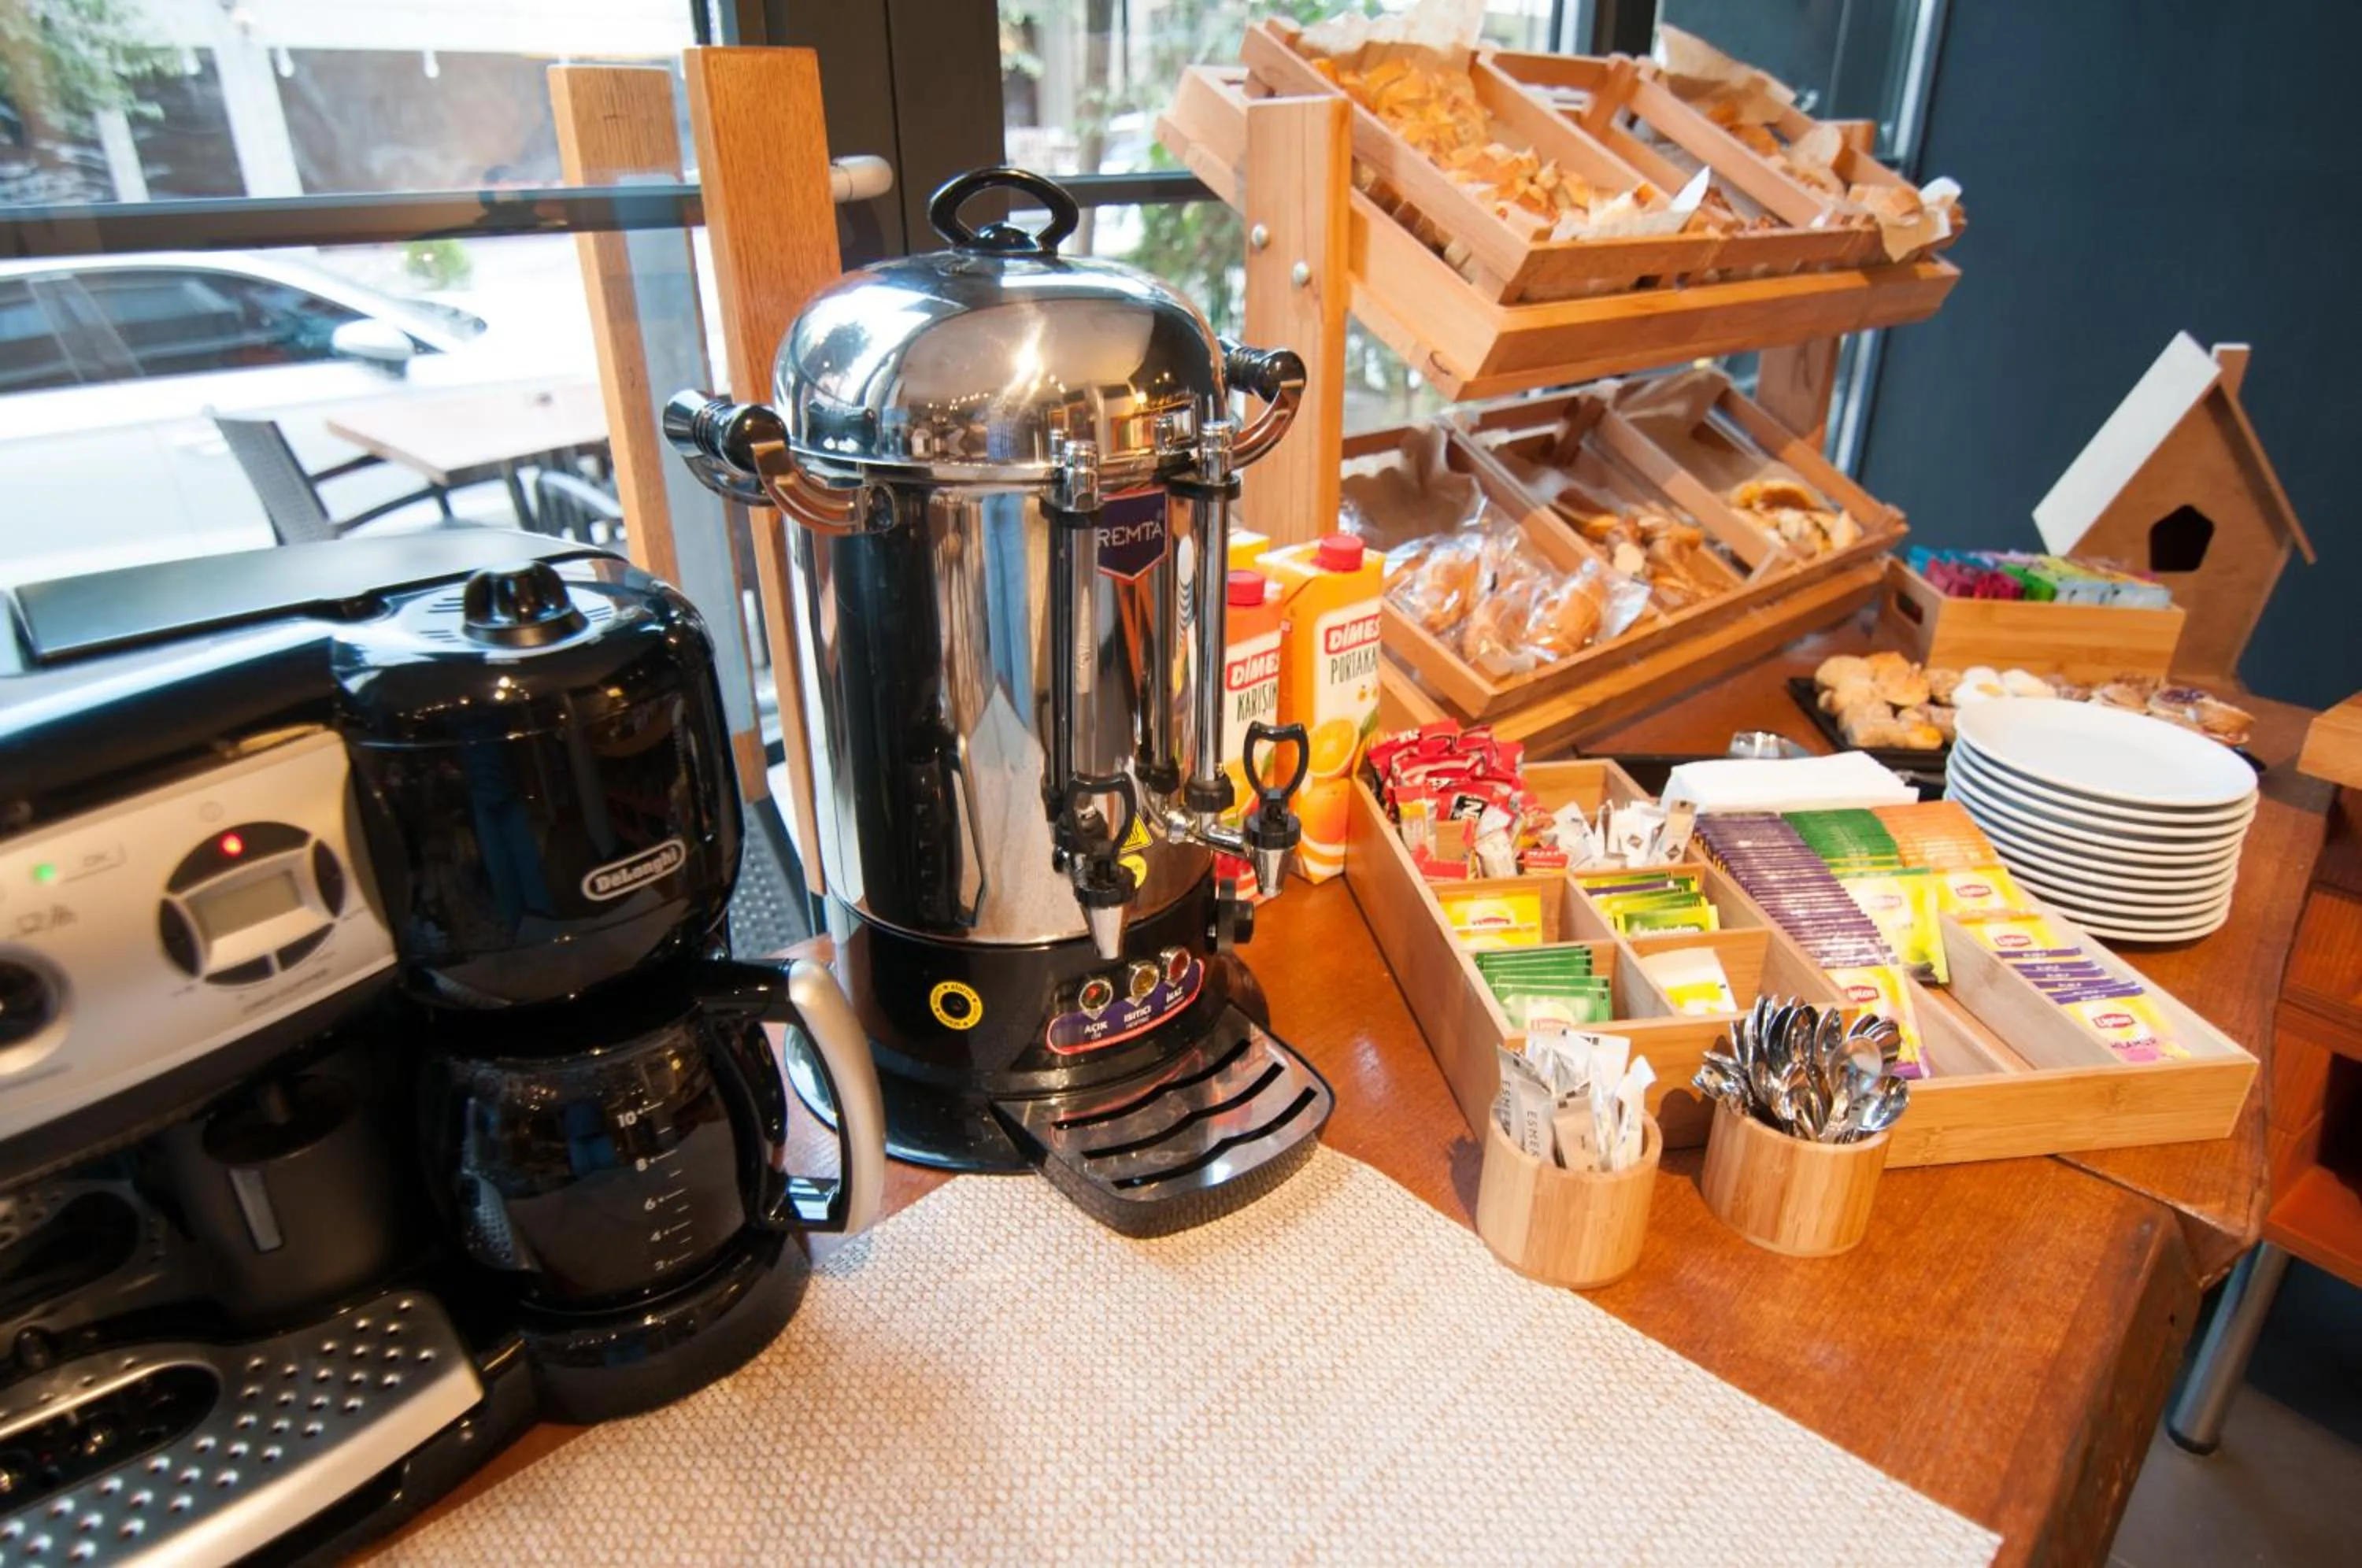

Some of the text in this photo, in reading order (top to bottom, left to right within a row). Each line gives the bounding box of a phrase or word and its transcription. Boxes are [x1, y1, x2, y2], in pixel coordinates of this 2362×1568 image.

[1097, 520, 1164, 547] REMTA
[1331, 645, 1379, 686] PORTAKA
[617, 1110, 637, 1128] 10
[635, 1158, 647, 1172] 8
[644, 1197, 656, 1211] 6
[650, 1230, 661, 1242] 4
